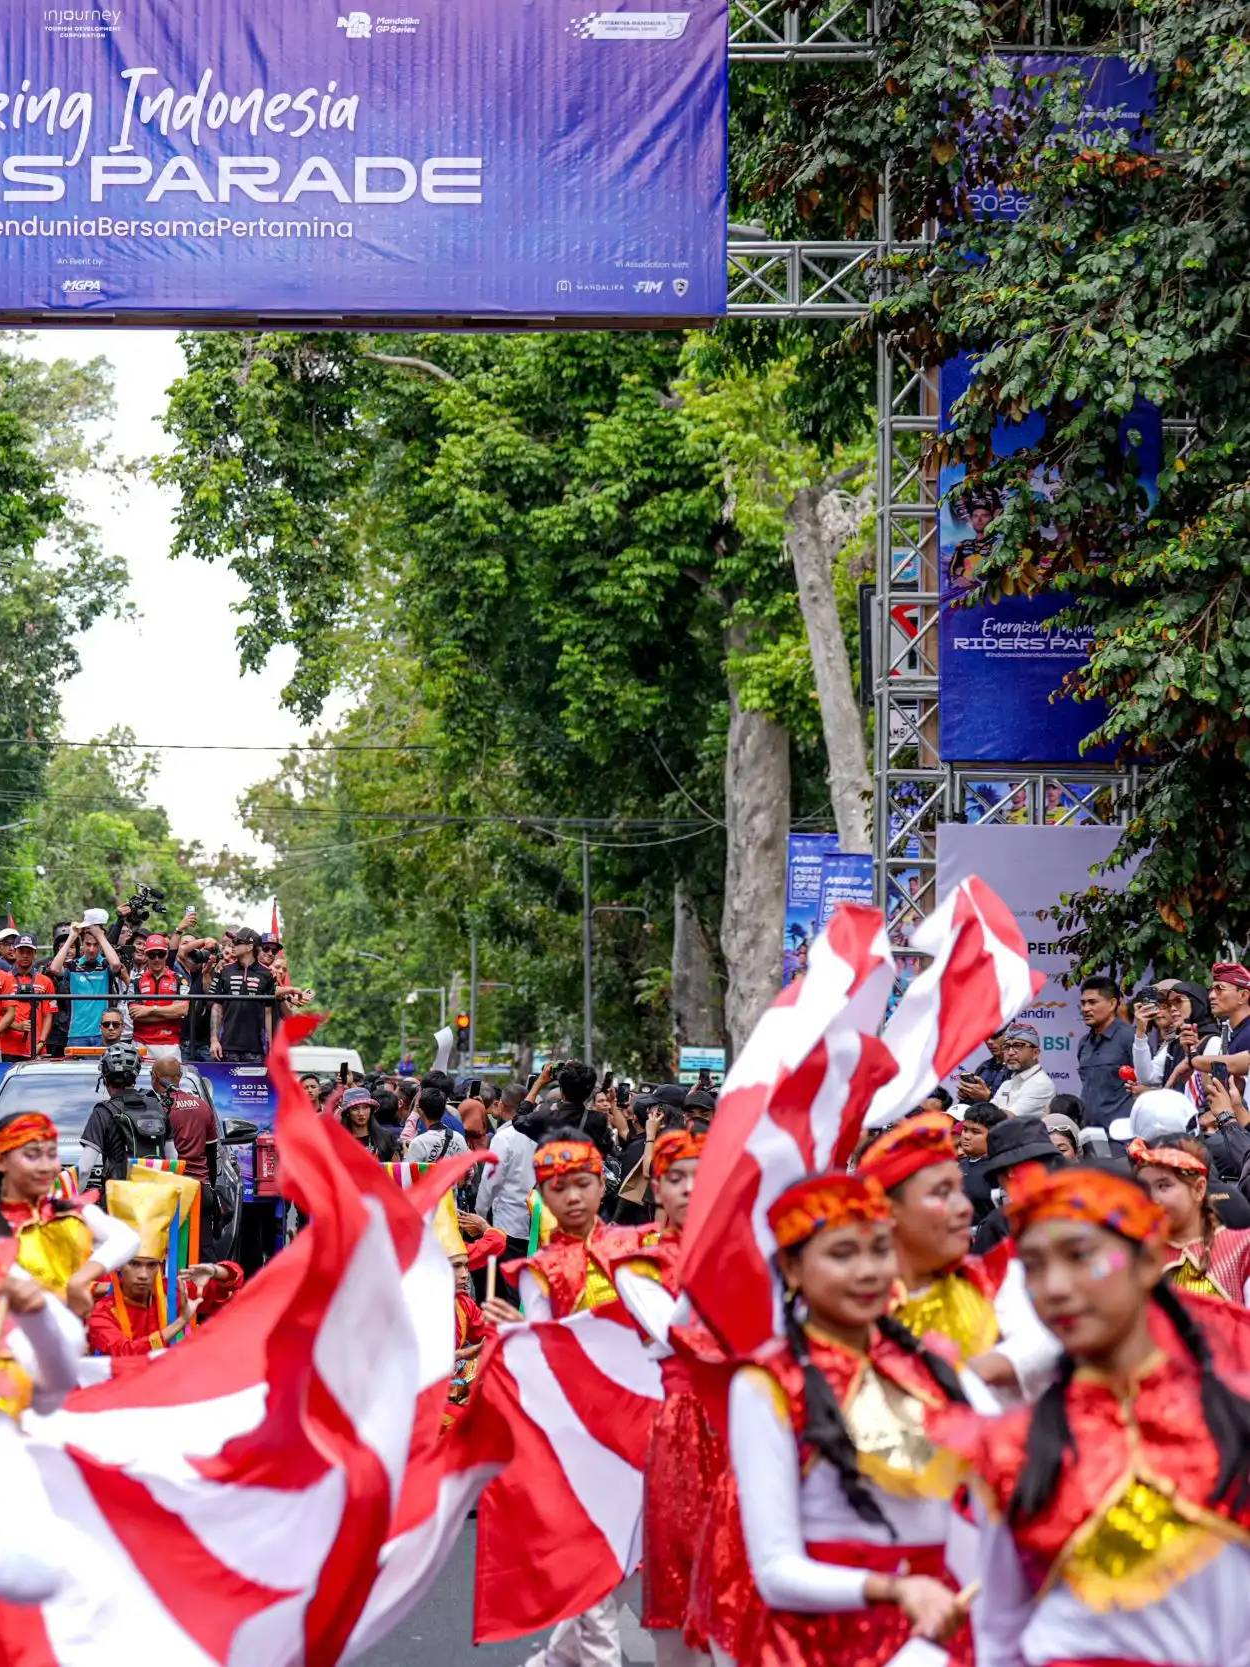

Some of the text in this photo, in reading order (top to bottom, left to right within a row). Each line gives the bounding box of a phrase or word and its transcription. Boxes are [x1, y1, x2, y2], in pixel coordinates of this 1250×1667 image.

[43, 9, 122, 26] injourney
[376, 16, 421, 25] Mandalika
[375, 25, 417, 34] GP Series
[108, 67, 359, 154] Indonesia
[91, 154, 483, 204] PARADE
[576, 284, 625, 292] MANDALIKA
[632, 280, 664, 294] FIM
[953, 637, 1046, 650] RIDERS
[1017, 1007, 1055, 1019] andiri
[1043, 1036, 1070, 1051] BSI
